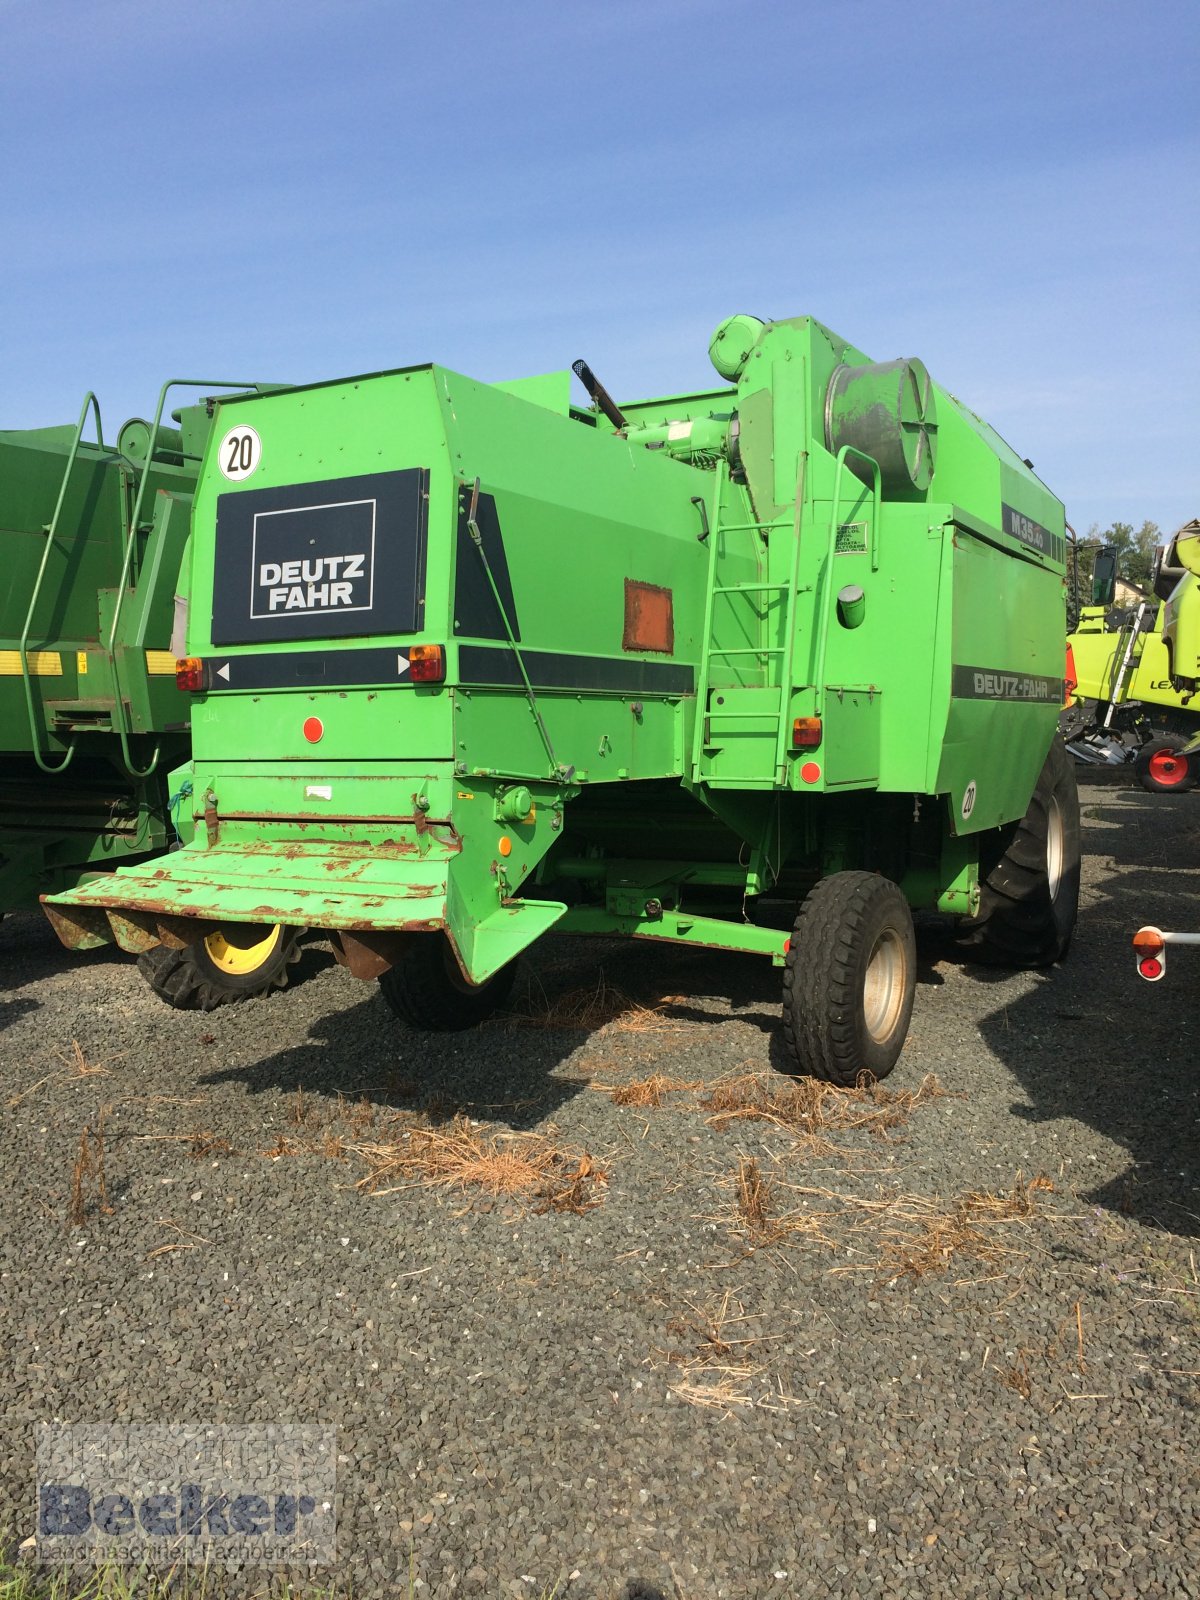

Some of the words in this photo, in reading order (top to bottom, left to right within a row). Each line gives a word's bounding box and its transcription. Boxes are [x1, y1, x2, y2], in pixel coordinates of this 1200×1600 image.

[227, 434, 253, 473] 20
[260, 554, 366, 587] DEUTZ
[269, 582, 353, 611] FAHR
[1150, 680, 1175, 690] LEX
[963, 787, 975, 813] 20
